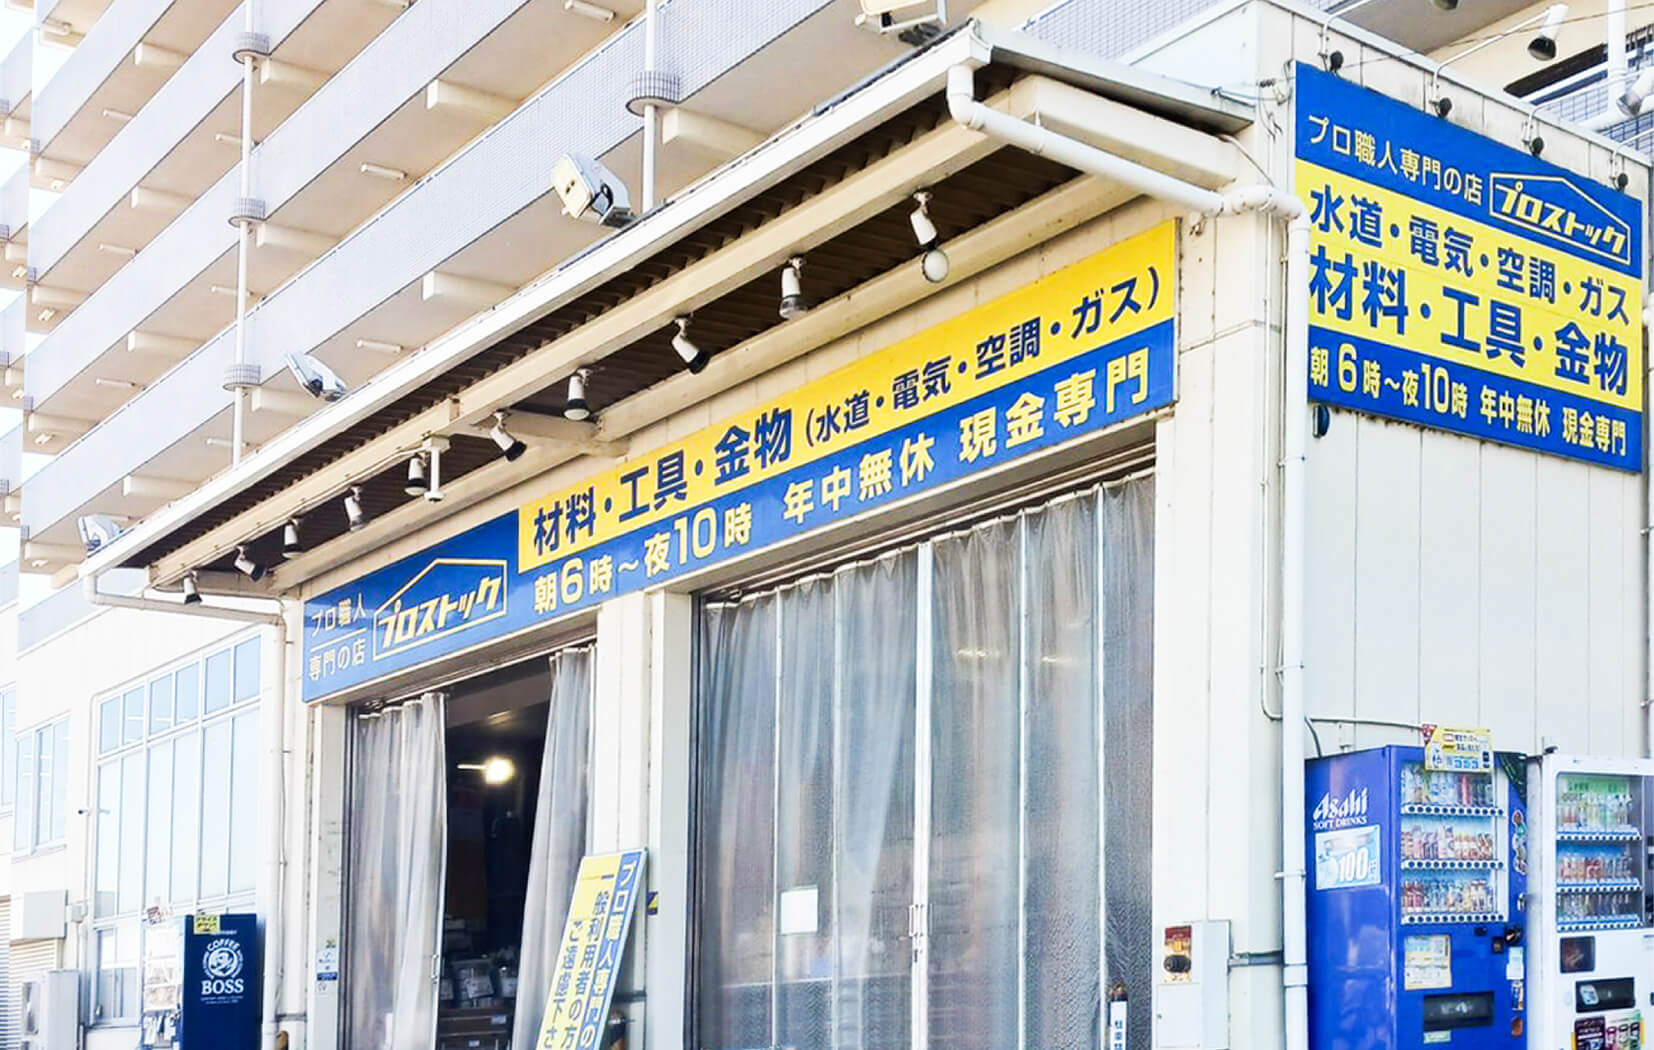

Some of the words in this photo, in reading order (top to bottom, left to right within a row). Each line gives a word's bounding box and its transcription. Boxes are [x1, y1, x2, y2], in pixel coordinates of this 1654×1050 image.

[1307, 115, 1484, 206] プロ職人専門の店
[1496, 182, 1626, 255] プロストック
[1310, 184, 1630, 326] 水道・電気・空調・ガス
[1309, 246, 1629, 396] 材料・工具・金物
[783, 434, 935, 525] 年中無休
[959, 346, 1149, 462] 現金専門
[1480, 385, 1551, 436] 年中無休
[1562, 407, 1627, 457] 現金専門
[533, 408, 791, 553] 材料・工具・金物
[311, 592, 367, 638] プロ職人
[378, 577, 502, 649] プロストック
[308, 636, 366, 682] 専門の店
[1313, 787, 1368, 821] Asahi
[1313, 819, 1335, 831] SOFT
[1338, 846, 1369, 883] 100
[206, 938, 240, 952] COFFEE
[201, 978, 244, 995] BOSS
